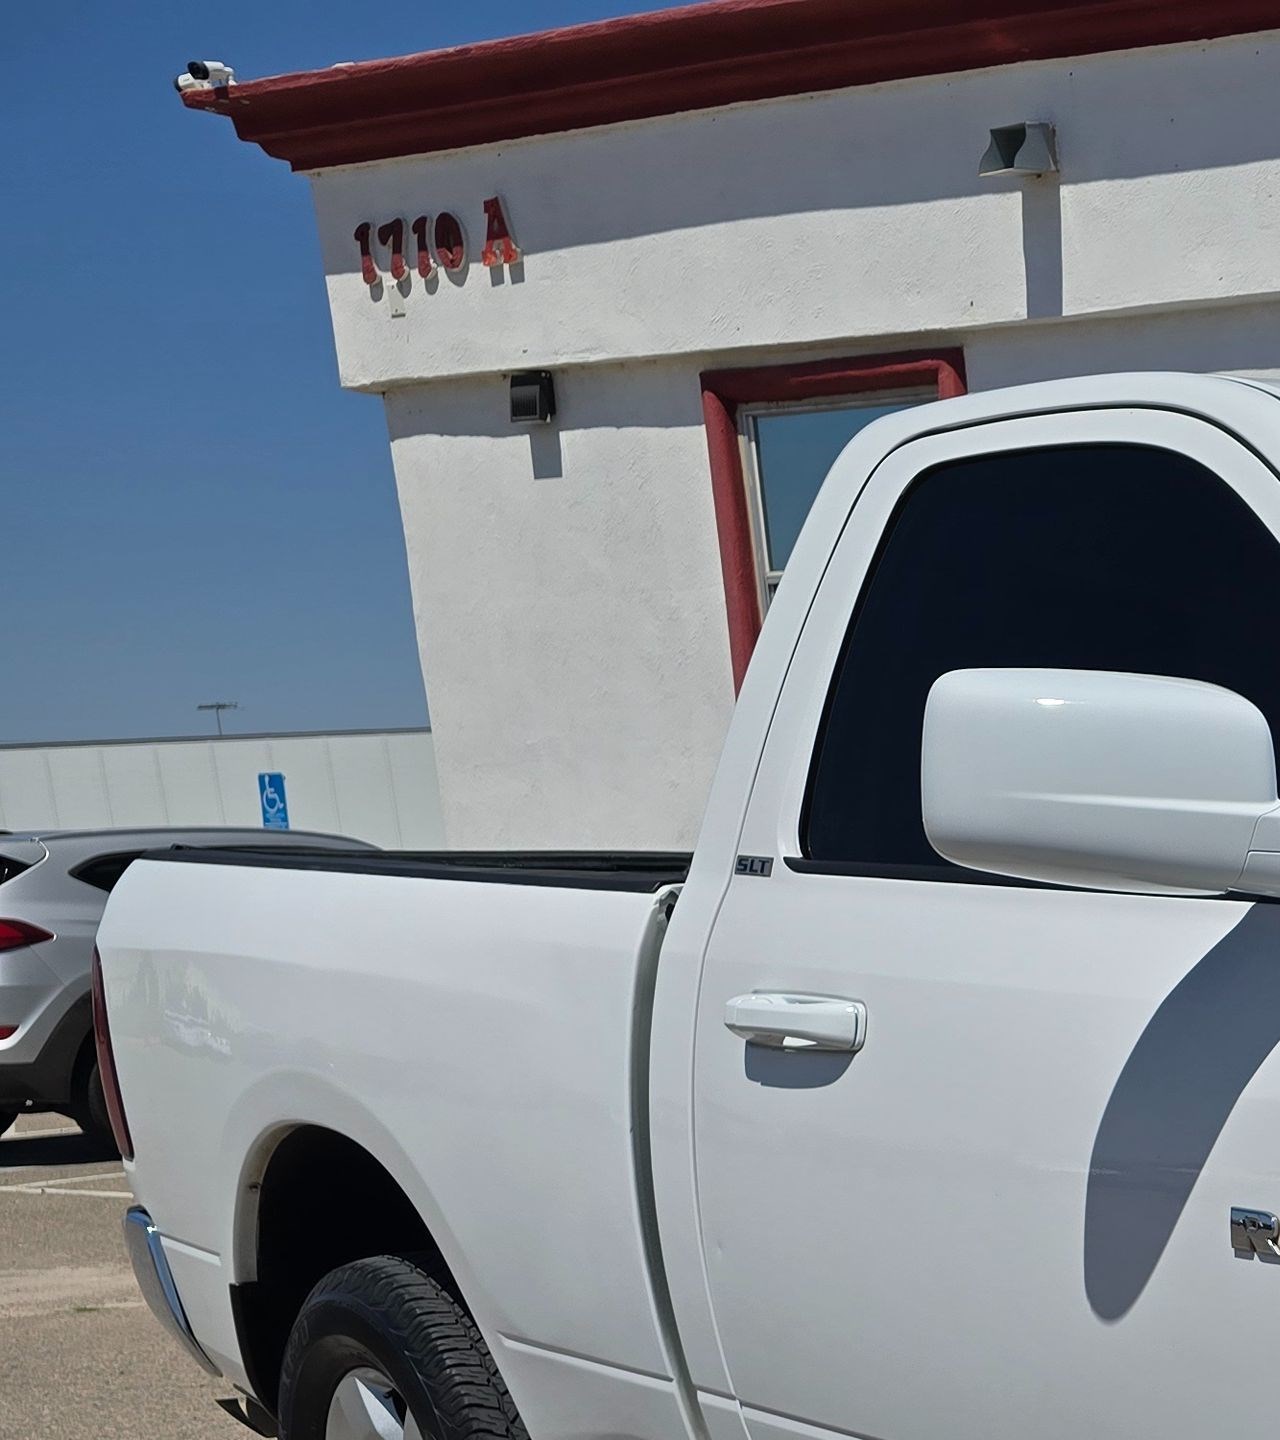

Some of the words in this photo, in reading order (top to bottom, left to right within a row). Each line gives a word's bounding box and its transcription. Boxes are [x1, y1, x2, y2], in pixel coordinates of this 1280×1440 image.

[354, 212, 464, 285] 1710
[482, 196, 519, 267] A
[736, 857, 770, 874] SLT
